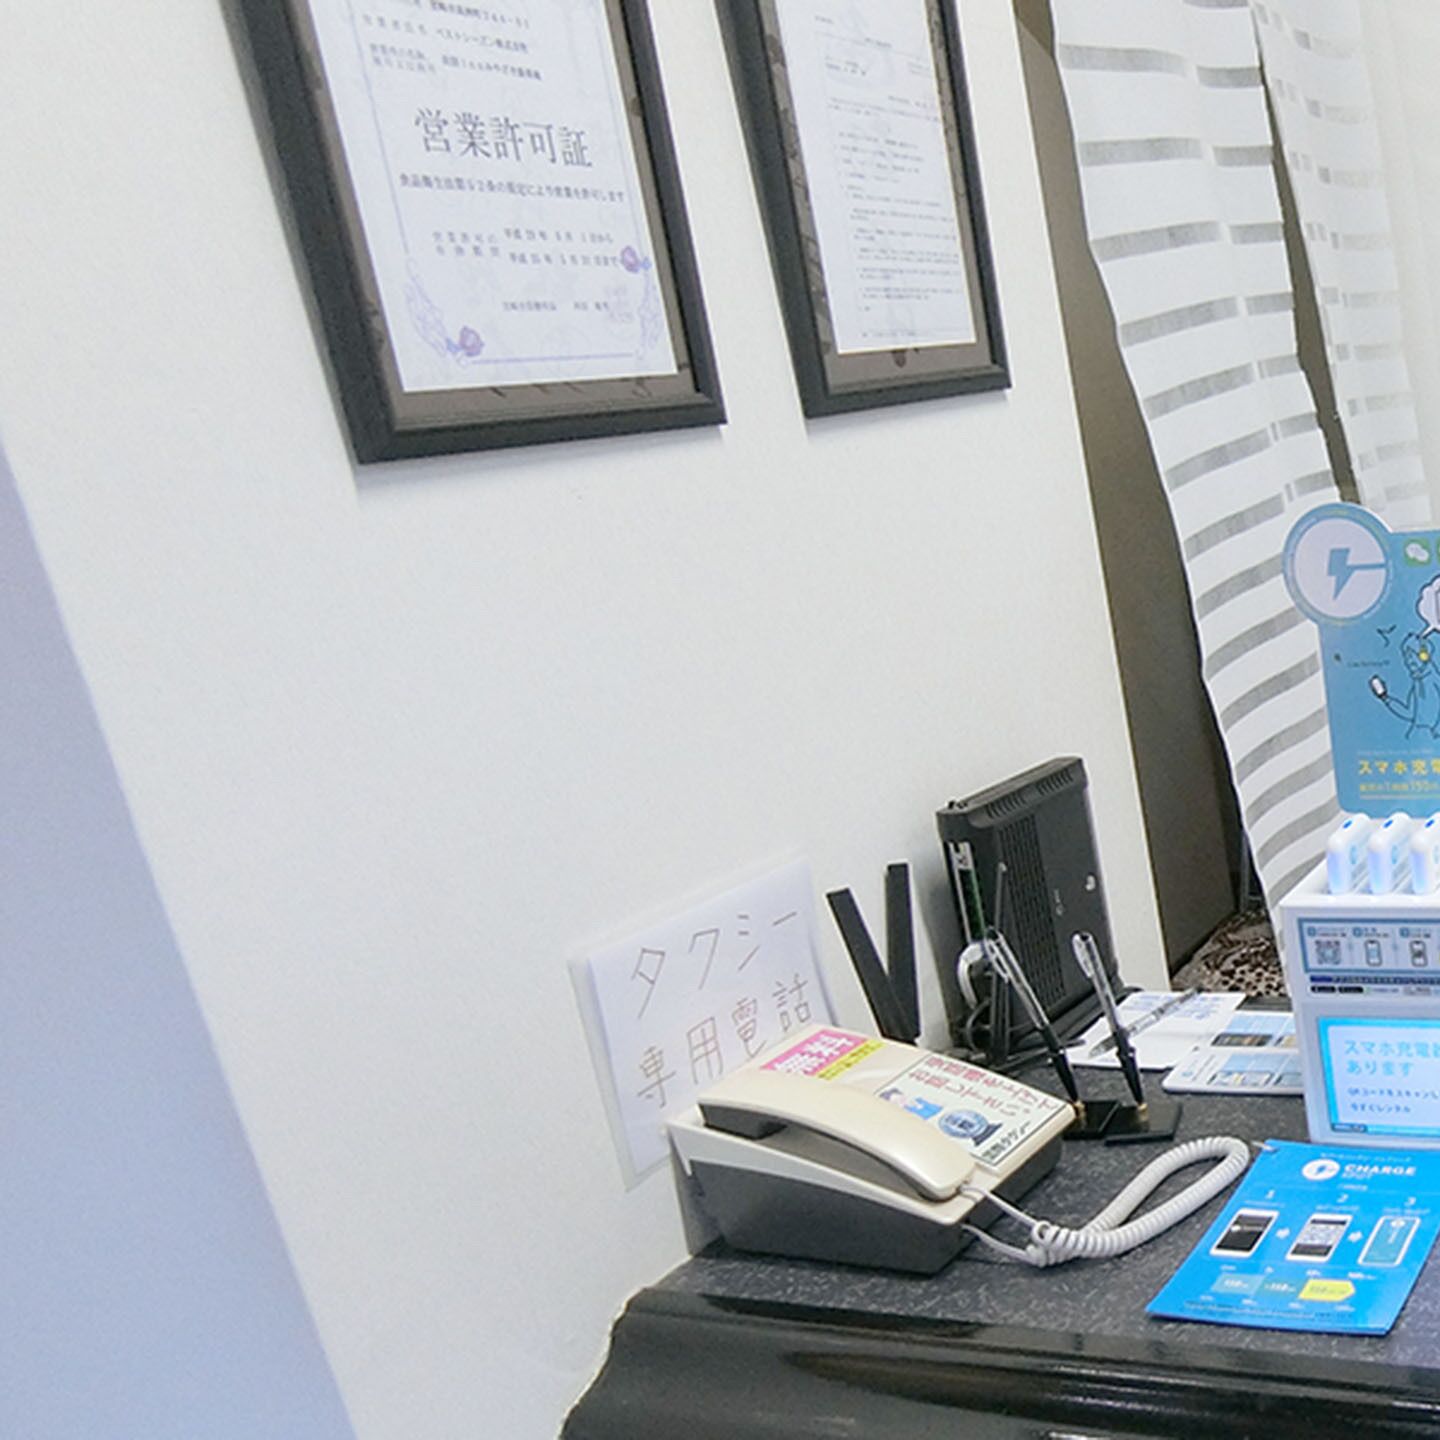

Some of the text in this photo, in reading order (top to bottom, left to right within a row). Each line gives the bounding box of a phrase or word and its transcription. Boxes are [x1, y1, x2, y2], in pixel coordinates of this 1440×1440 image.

[413, 107, 593, 168] 営業許可証
[629, 910, 798, 1020] タクシー
[637, 973, 812, 1111] 専用電話
[1346, 1060, 1414, 1076] あります
[1343, 1163, 1417, 1176] CHARGE
[1336, 1193, 1349, 1203] 2
[1404, 1196, 1417, 1206] 3
